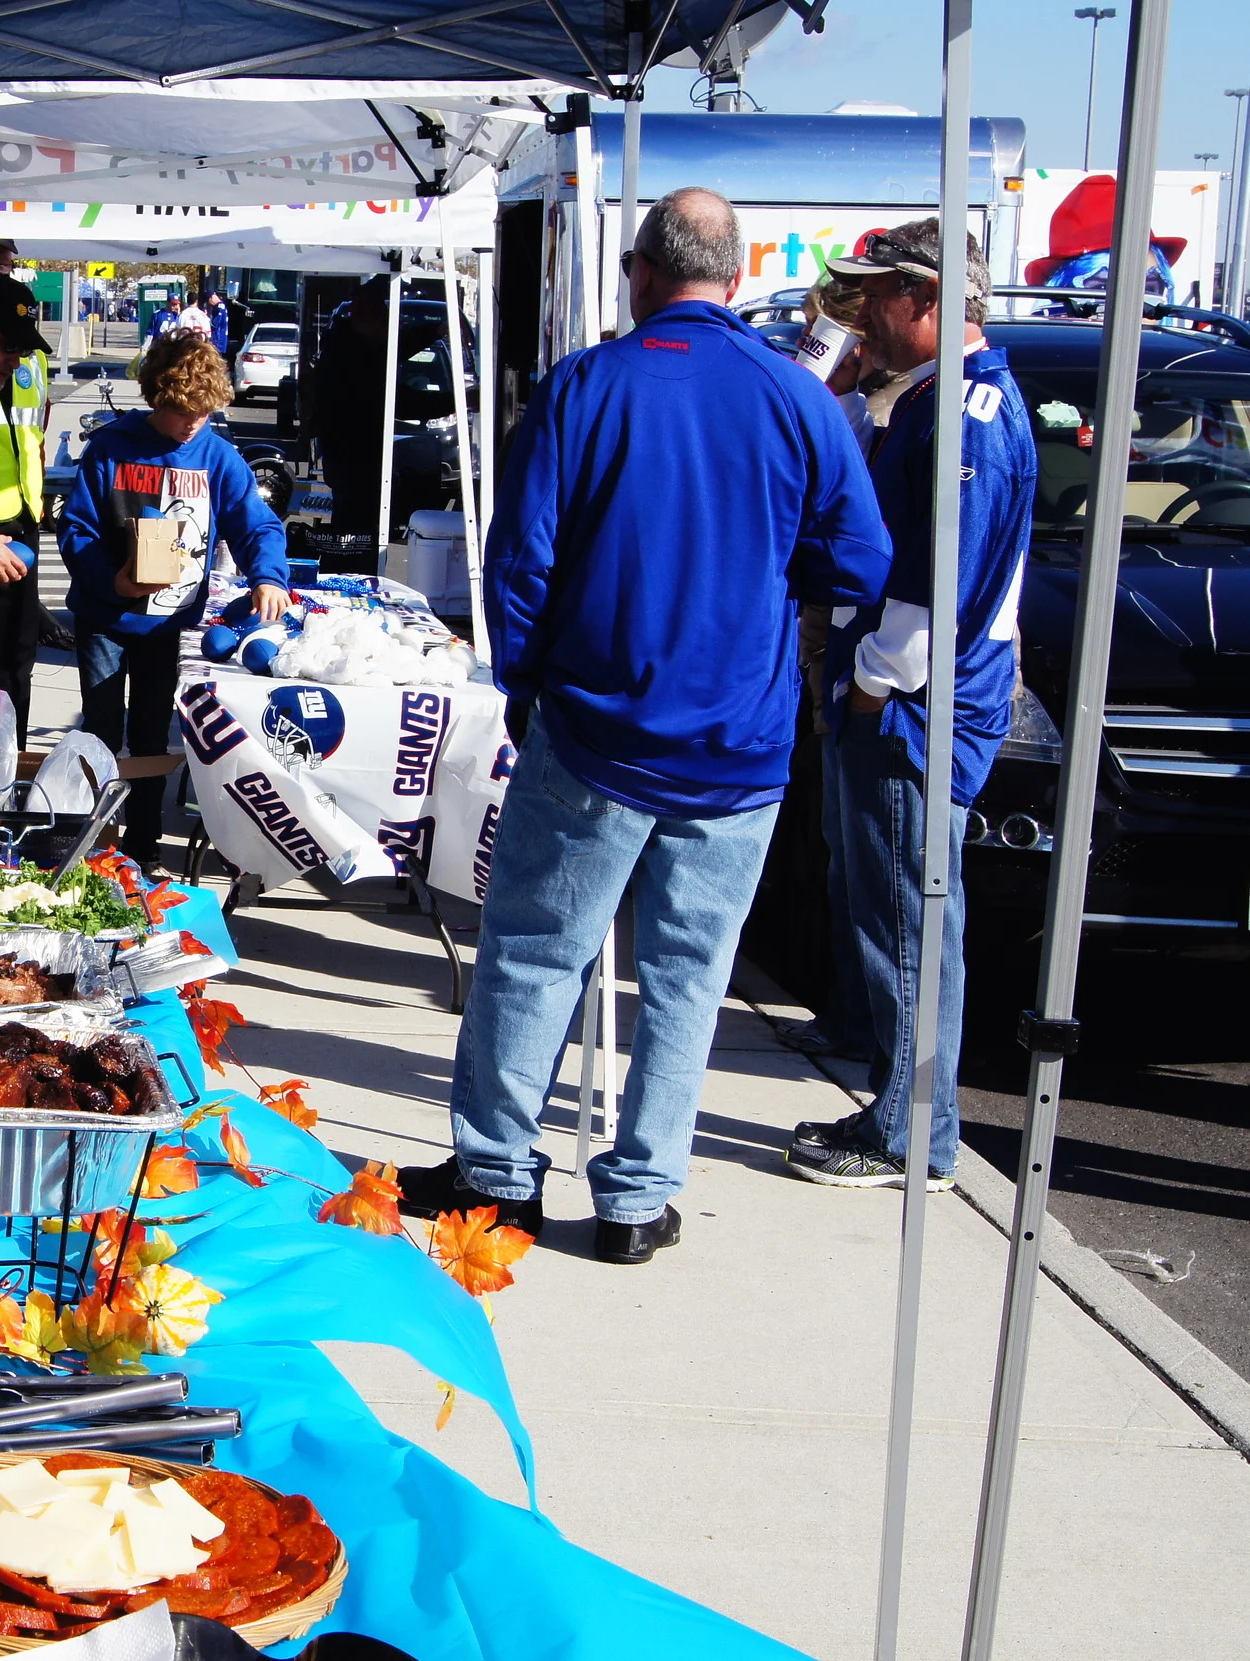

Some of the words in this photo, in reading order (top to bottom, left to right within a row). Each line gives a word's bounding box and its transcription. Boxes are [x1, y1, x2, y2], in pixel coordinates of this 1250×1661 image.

[113, 462, 165, 495] ANGRY
[167, 467, 210, 499] BIRDS
[392, 691, 440, 797] GIANTS
[234, 771, 330, 868] GIANTS
